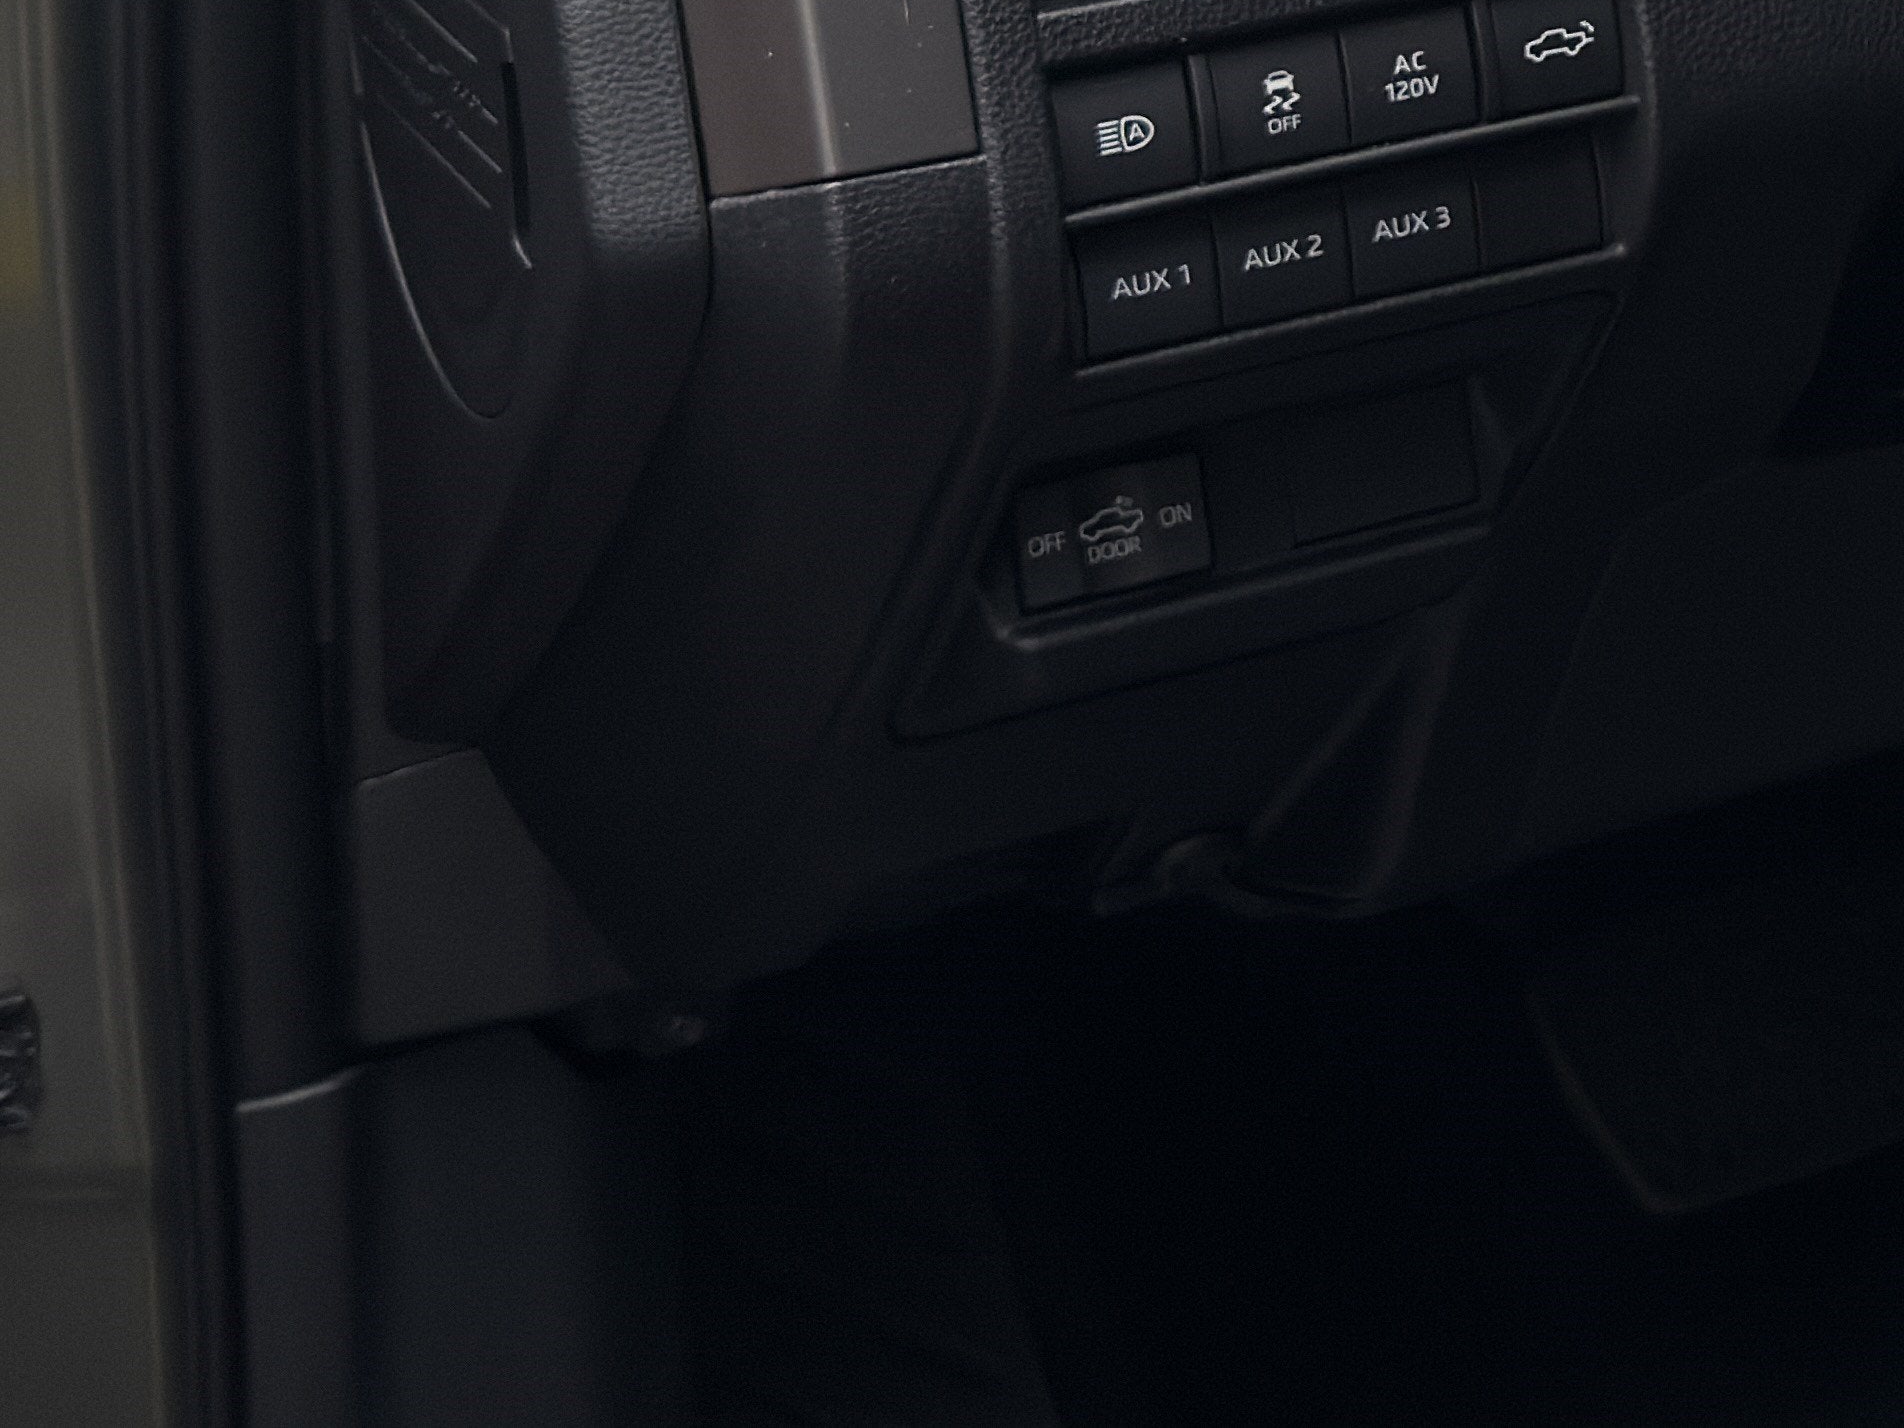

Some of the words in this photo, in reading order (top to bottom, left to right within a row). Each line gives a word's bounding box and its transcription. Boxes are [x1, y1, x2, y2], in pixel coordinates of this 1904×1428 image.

[1393, 50, 1427, 75] AC
[1384, 74, 1440, 102] 120V
[1267, 113, 1302, 135] OFF
[1372, 210, 1429, 243] AUX
[1435, 206, 1451, 230] 3
[1243, 239, 1301, 271] AUX
[1308, 234, 1324, 259] 2
[1111, 267, 1172, 300] AUX
[1179, 264, 1192, 286] 1
[1158, 502, 1193, 528] ON
[1027, 530, 1066, 558] OFF
[1086, 535, 1142, 564] DOOR
